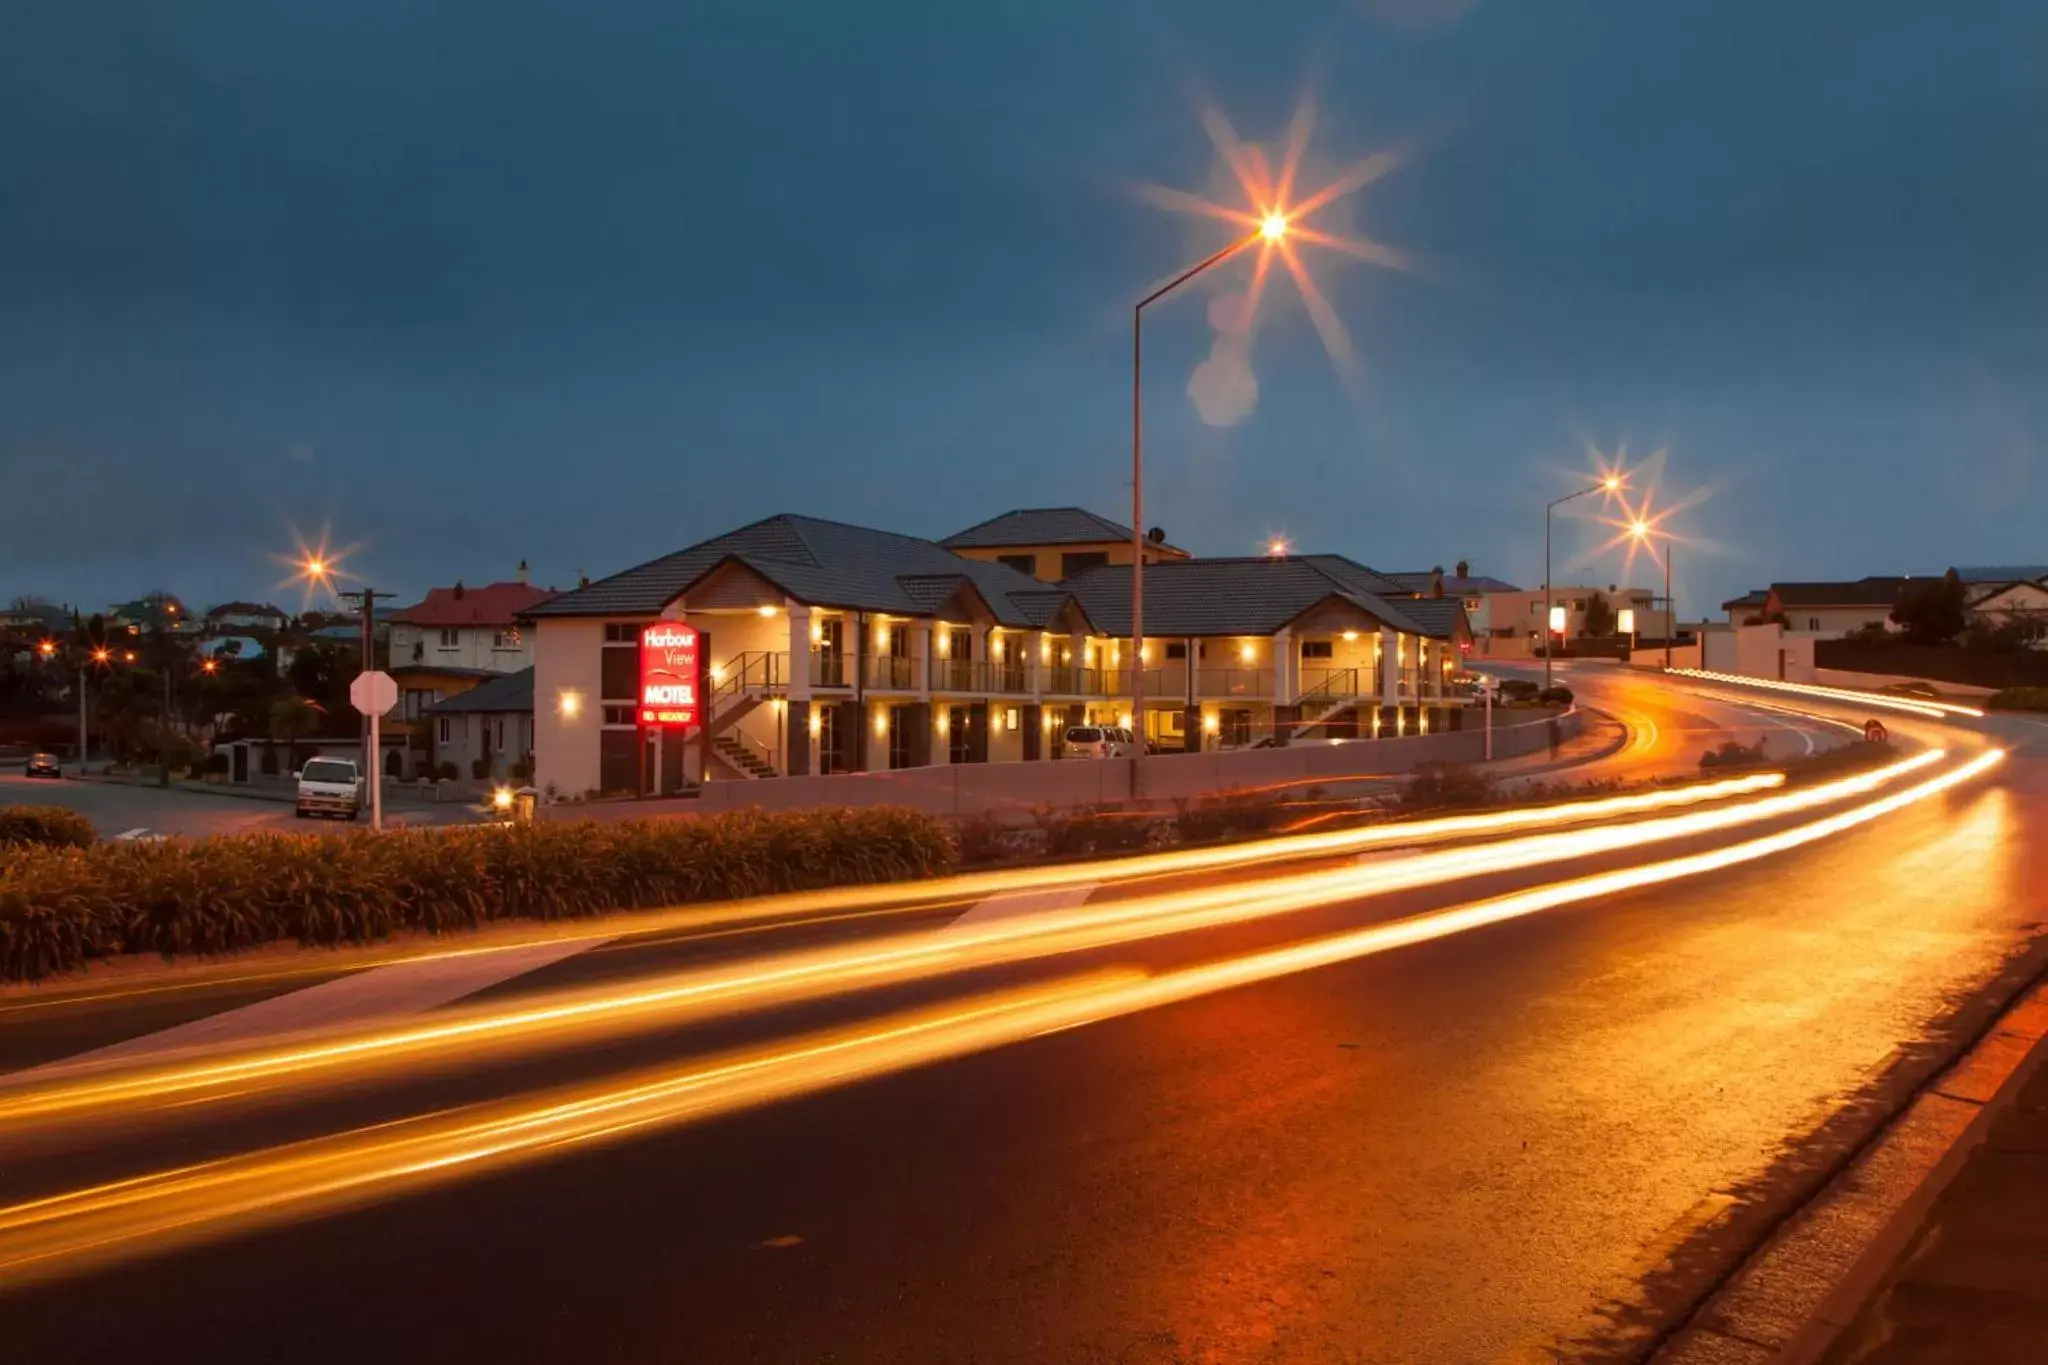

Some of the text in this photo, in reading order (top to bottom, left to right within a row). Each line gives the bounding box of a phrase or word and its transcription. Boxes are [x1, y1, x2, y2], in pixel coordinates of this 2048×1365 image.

[644, 628, 695, 647] Harbour
[664, 648, 694, 666] View
[645, 685, 694, 704] MOTEL
